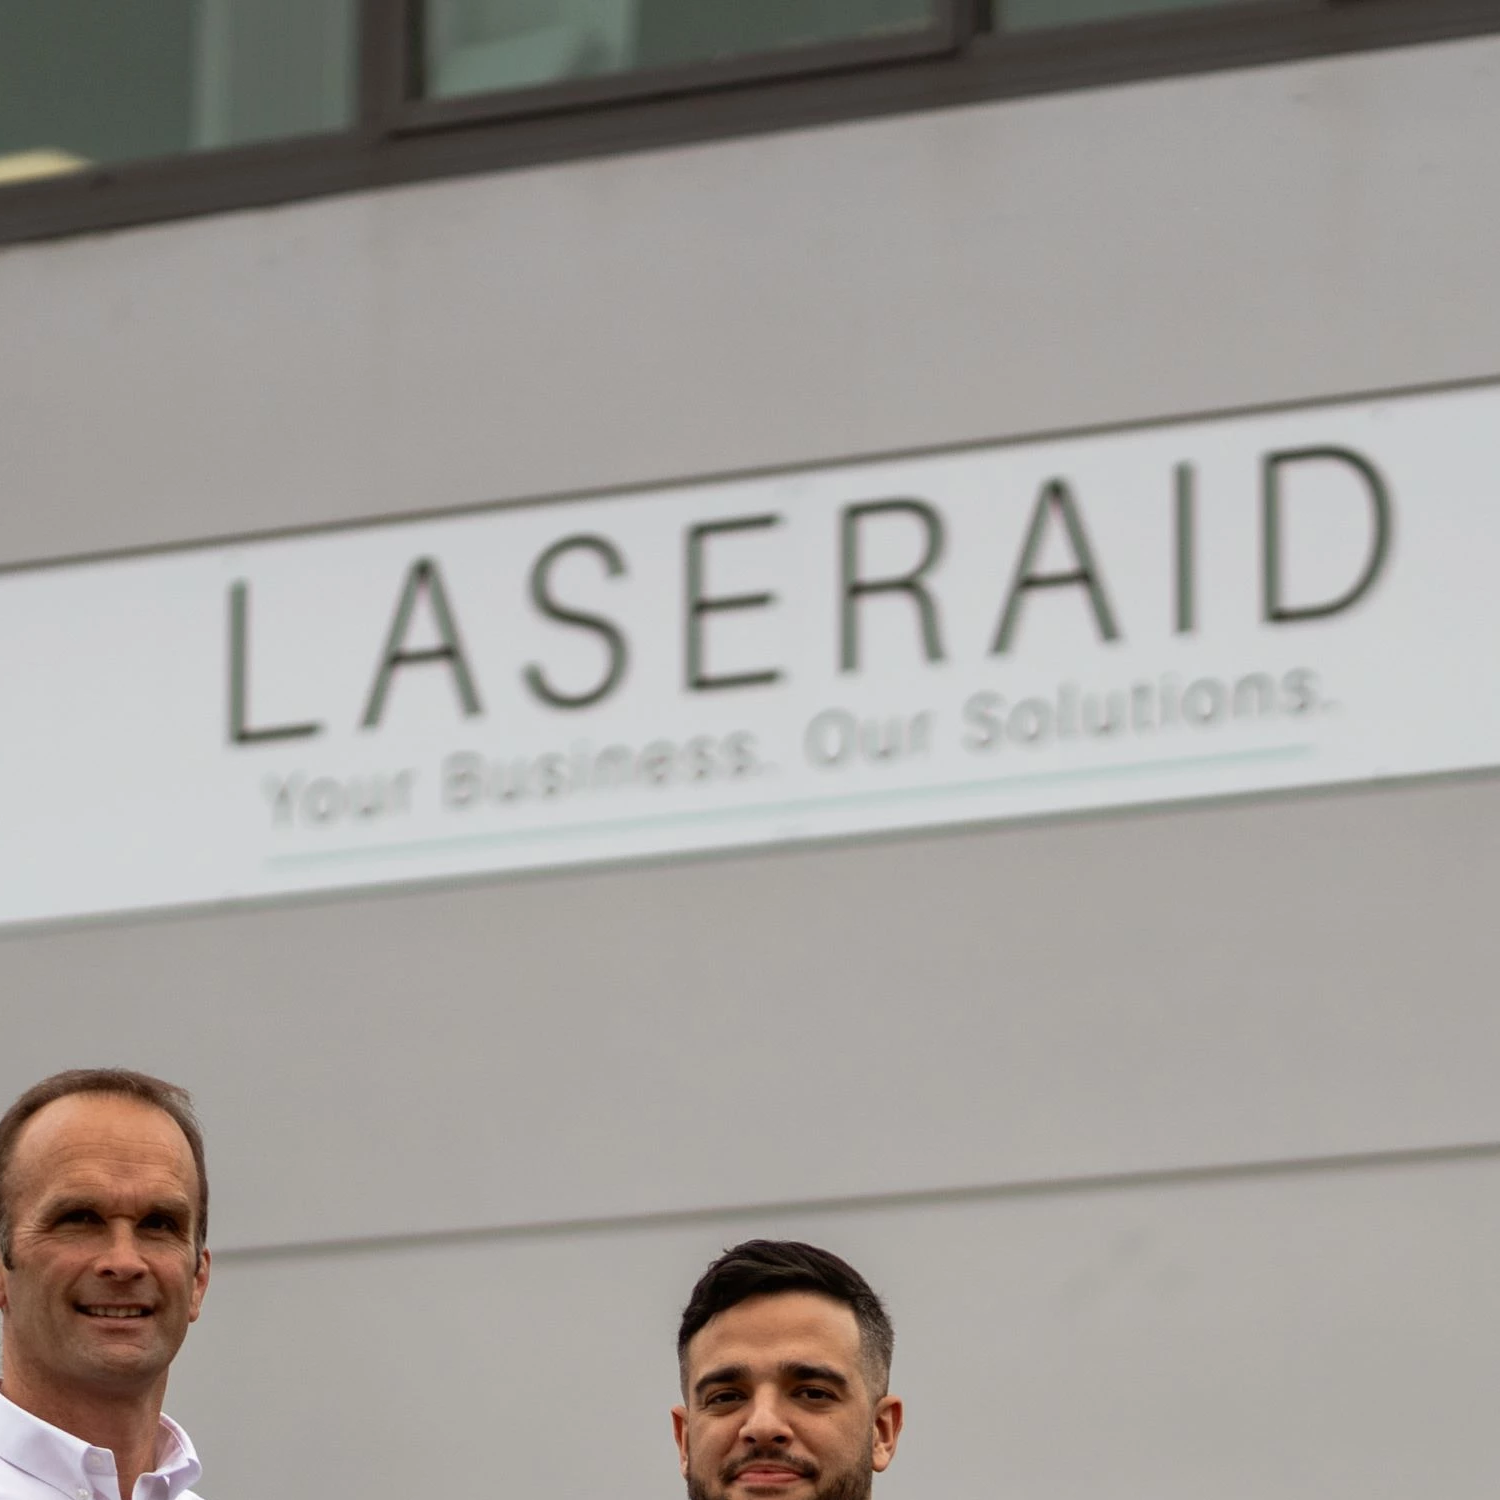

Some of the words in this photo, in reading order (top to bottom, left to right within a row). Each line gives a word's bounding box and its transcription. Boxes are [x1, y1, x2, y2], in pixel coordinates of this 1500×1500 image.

[227, 442, 1397, 747] LASERAID
[262, 764, 414, 828] Your
[440, 730, 780, 808] Business.
[804, 707, 934, 768] Our
[960, 665, 1343, 750] Solutions.
